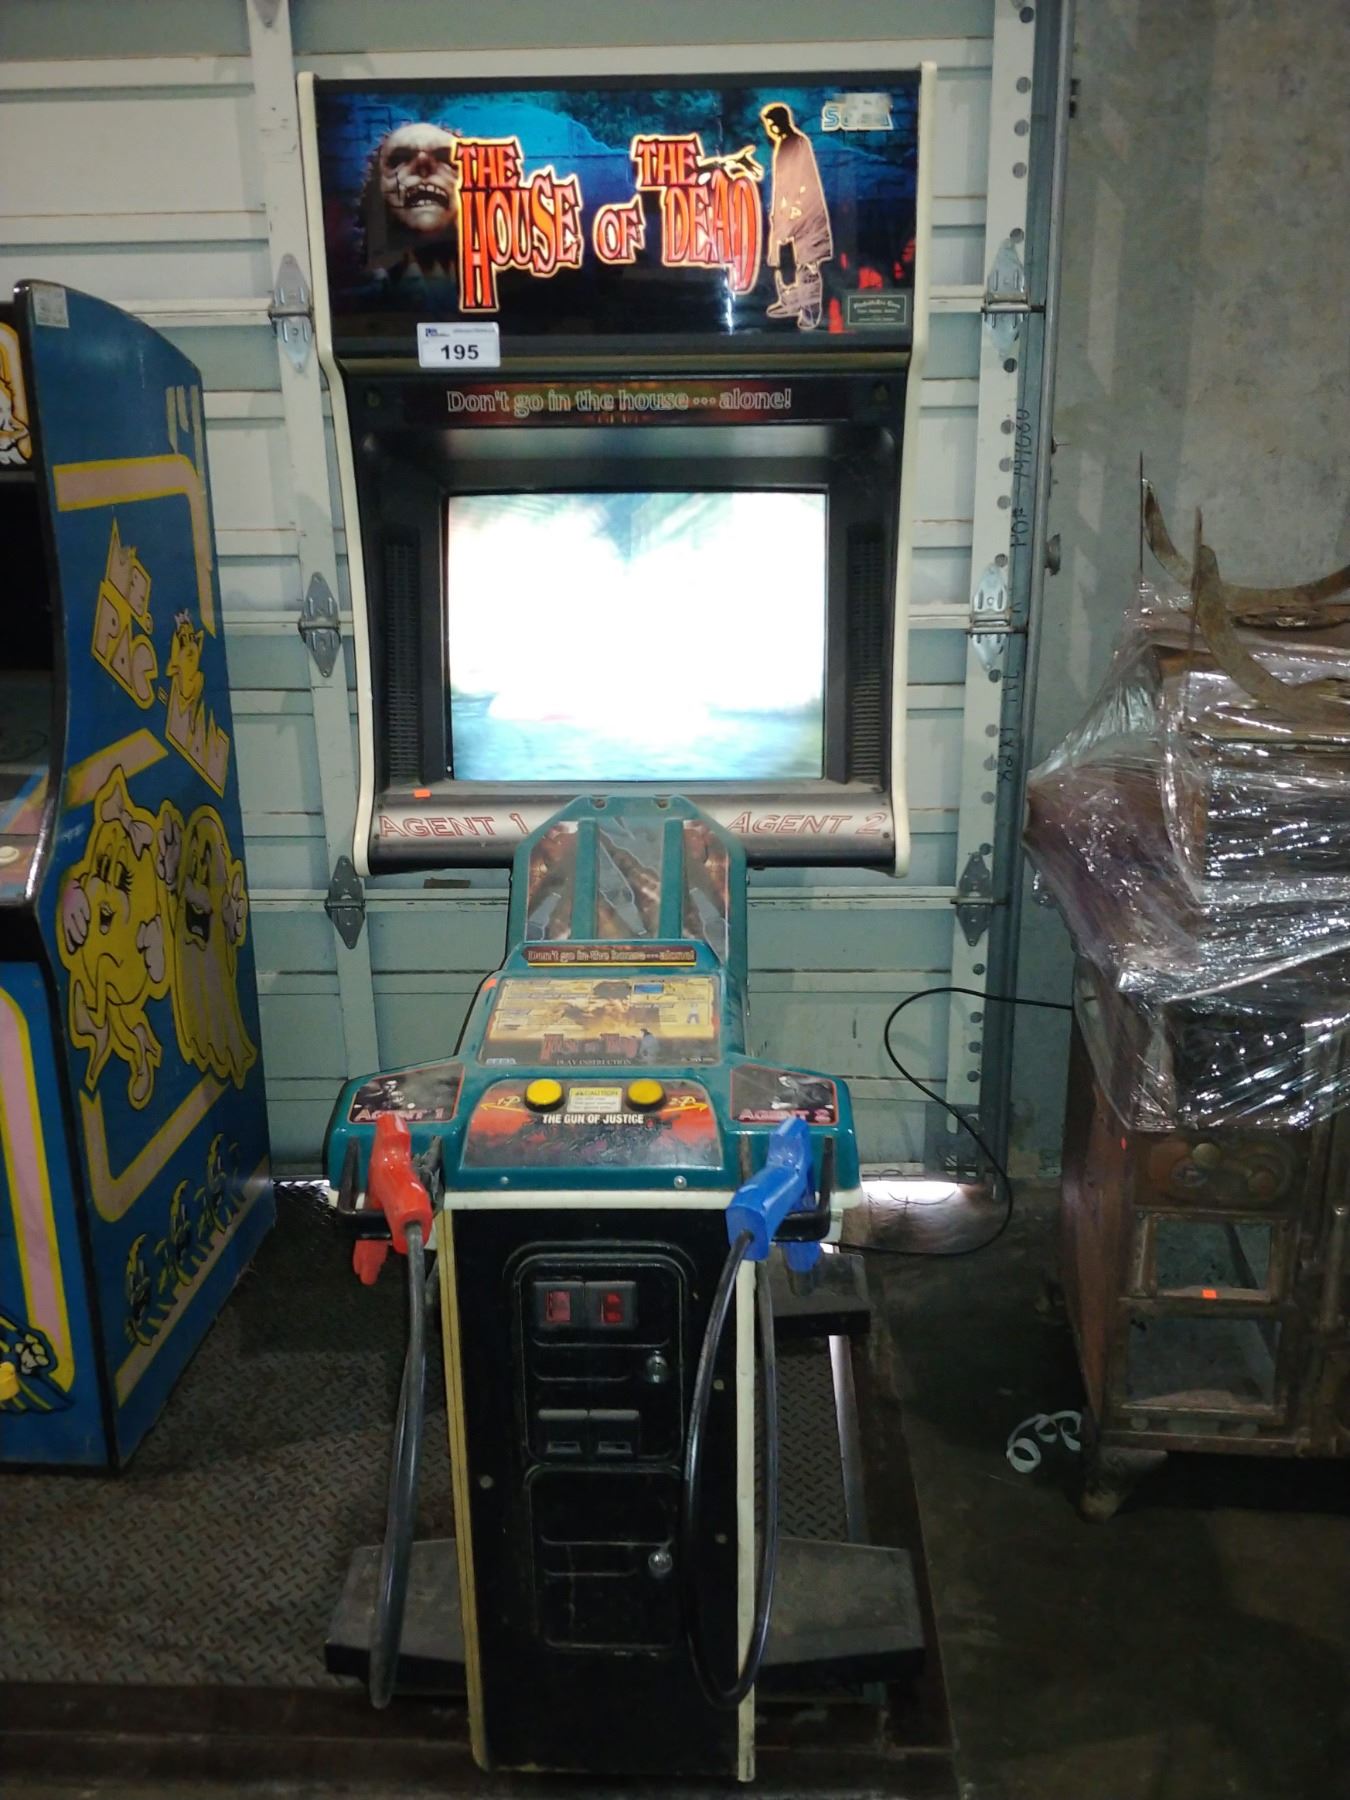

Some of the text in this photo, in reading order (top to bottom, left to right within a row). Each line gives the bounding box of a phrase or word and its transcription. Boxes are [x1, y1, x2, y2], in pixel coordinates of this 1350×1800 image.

[455, 141, 520, 190] THE
[635, 138, 702, 188] THE
[460, 174, 643, 309] HOUSE OF
[664, 168, 761, 292] DEAD
[441, 344, 479, 360] 195
[447, 390, 509, 413] Don't
[513, 393, 544, 418] go
[549, 390, 571, 412] in
[575, 389, 614, 411] the
[618, 389, 689, 411] house
[719, 388, 792, 410] alone!
[378, 812, 530, 838] AGENT 1
[727, 811, 888, 835] AGENT 2
[543, 1114, 644, 1124] THE GUN OF JUSTICE
